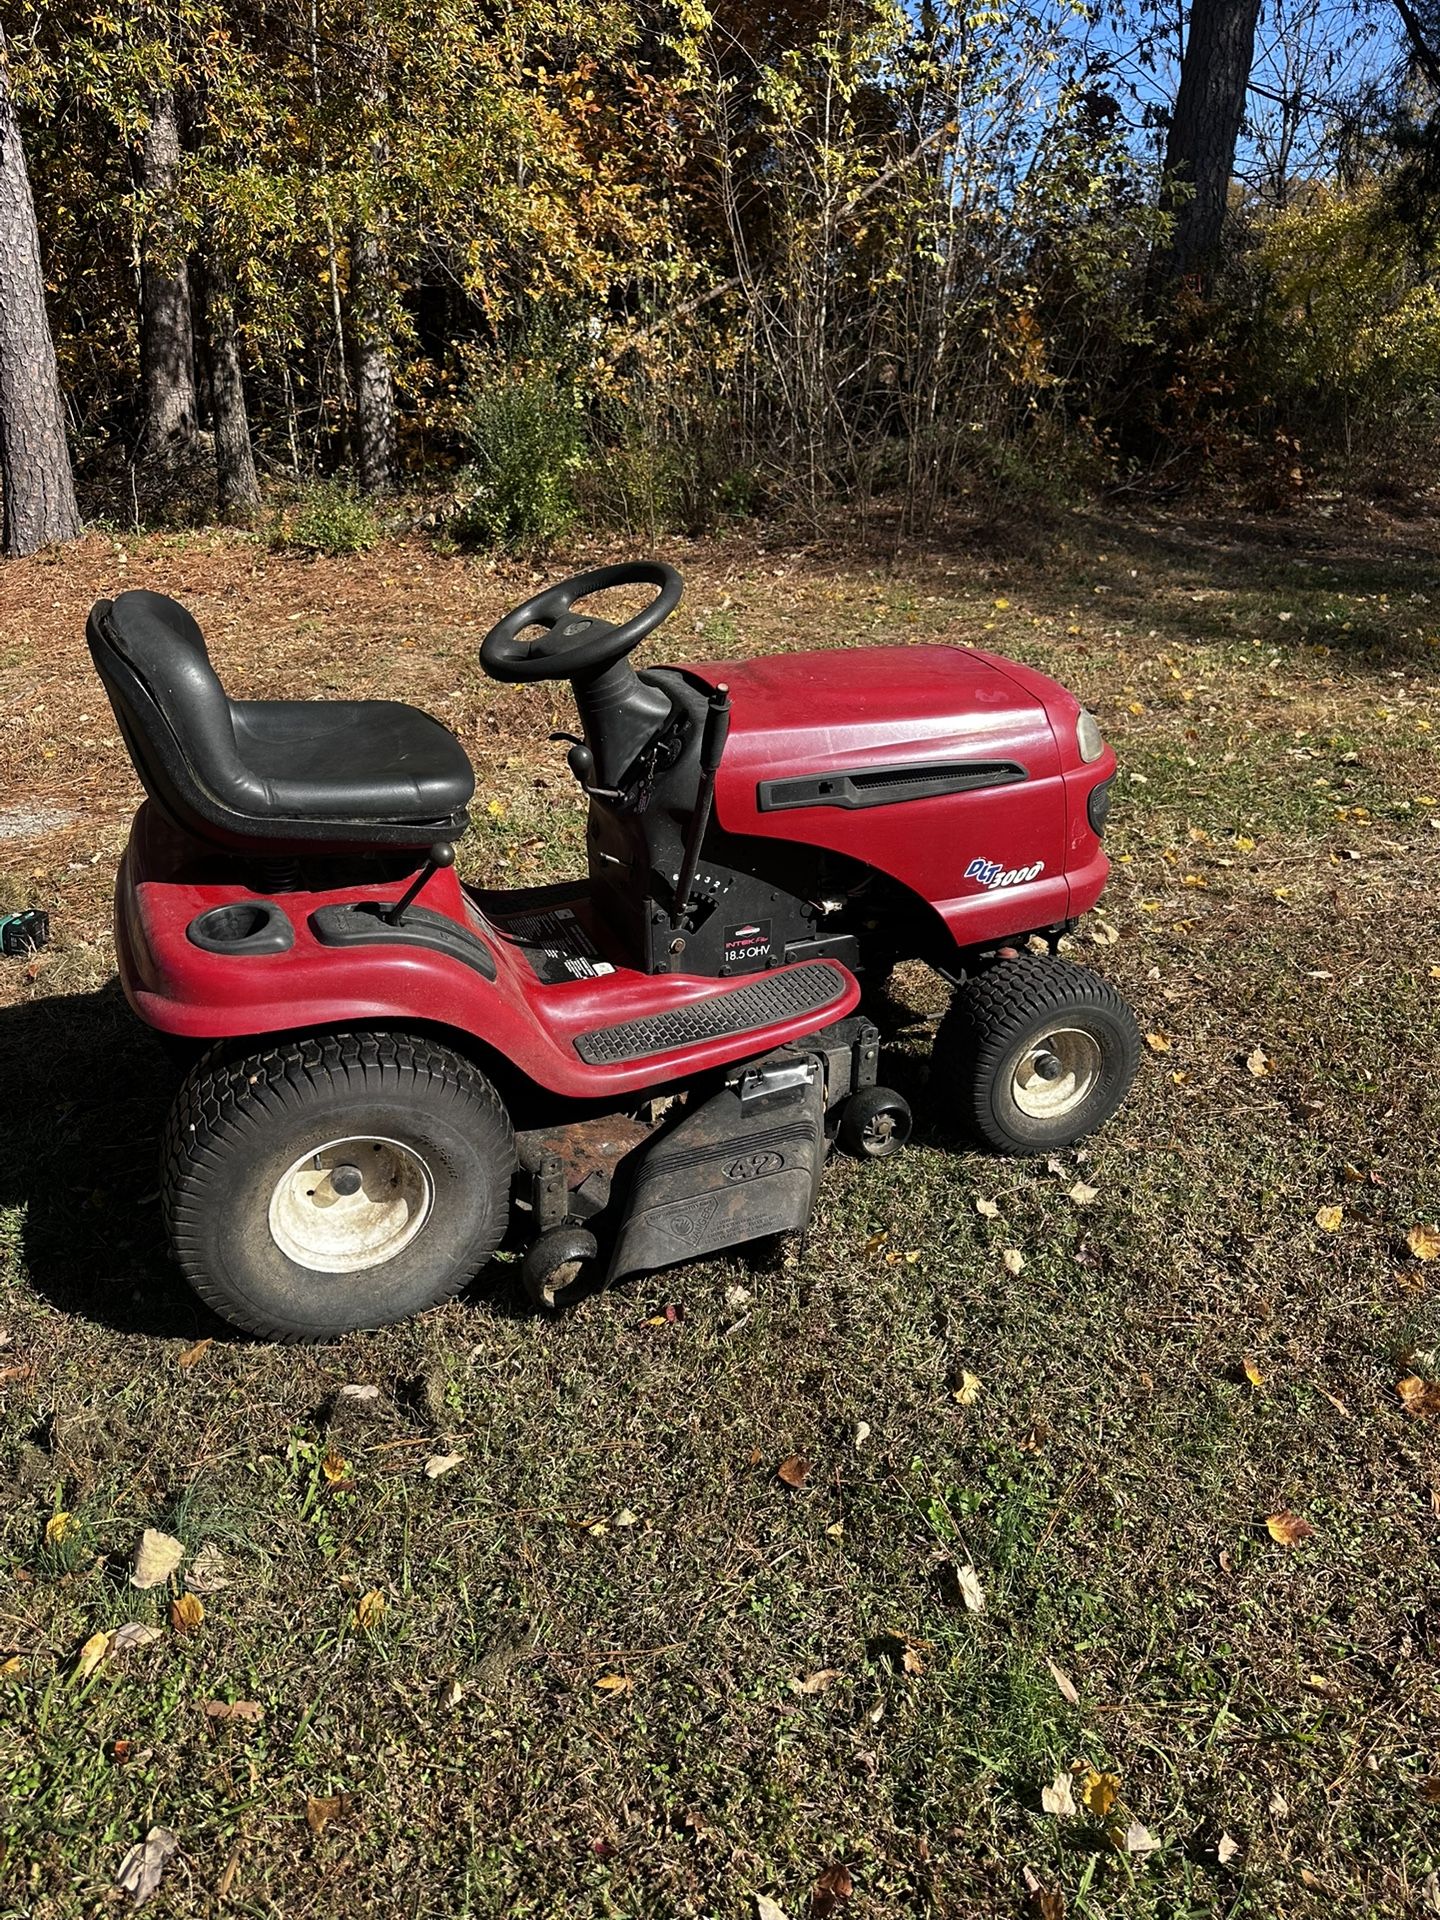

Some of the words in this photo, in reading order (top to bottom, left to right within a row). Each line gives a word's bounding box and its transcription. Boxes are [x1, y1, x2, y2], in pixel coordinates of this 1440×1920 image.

[672, 873, 680, 881] 6
[694, 873, 701, 881] 4
[704, 876, 711, 884] 3
[988, 861, 1045, 890] 3000
[724, 949, 746, 962] 18.5
[746, 944, 771, 958] OHV
